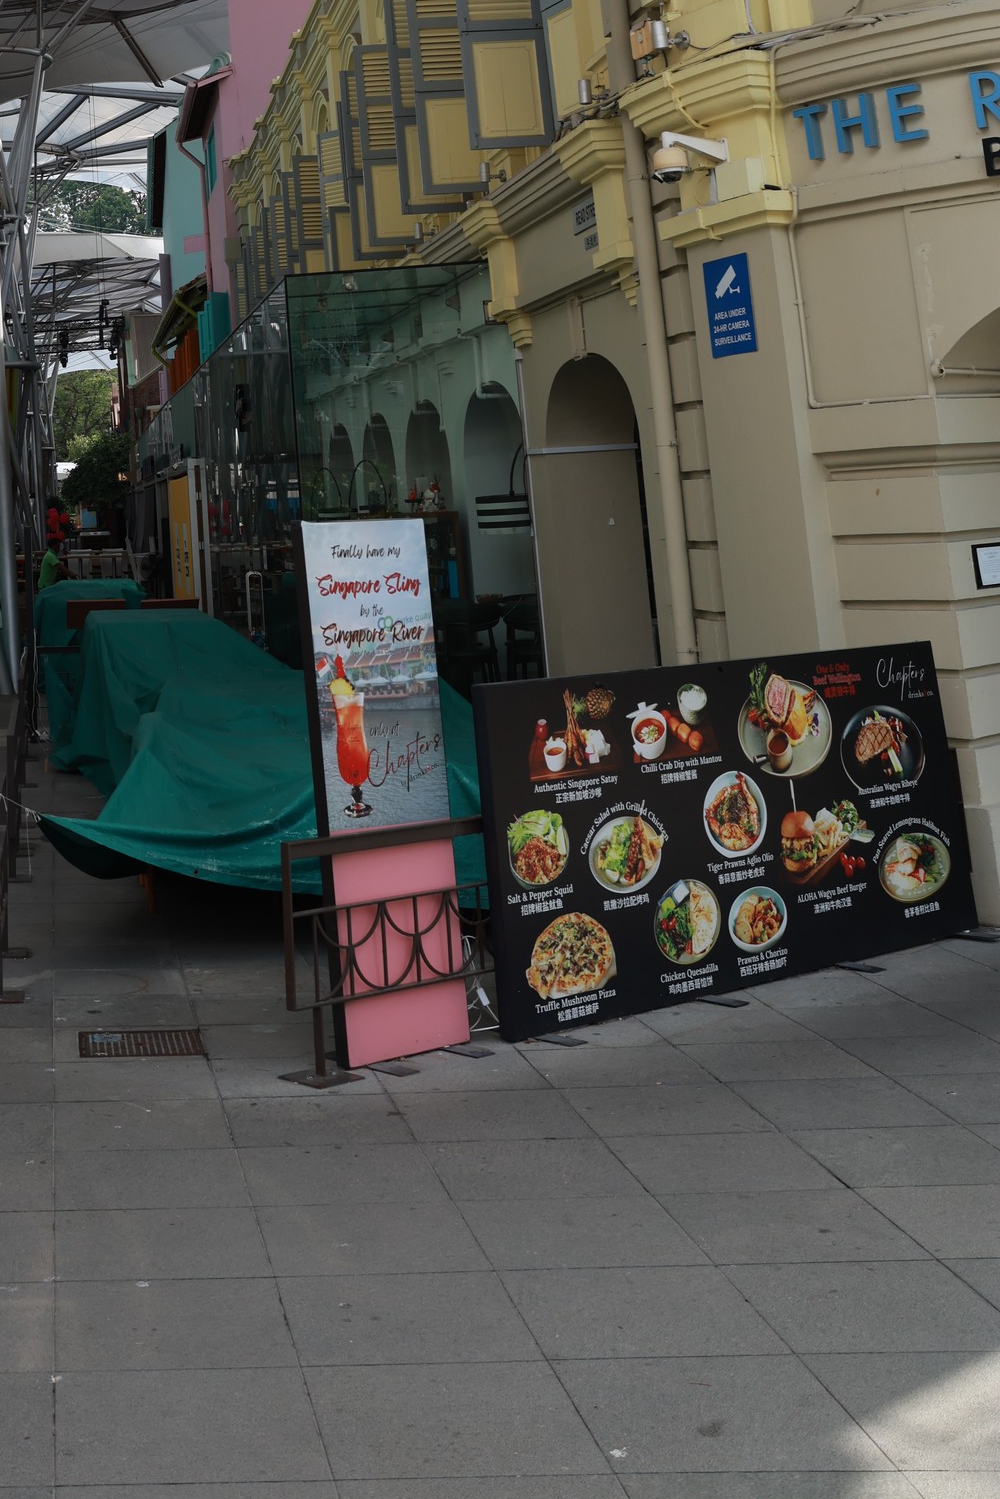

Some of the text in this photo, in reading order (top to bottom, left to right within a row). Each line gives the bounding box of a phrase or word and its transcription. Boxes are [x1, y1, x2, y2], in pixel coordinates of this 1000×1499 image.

[792, 83, 929, 161] THE
[714, 307, 746, 321] AREA UNDER
[713, 320, 750, 334] 24-HR CAMERA
[714, 332, 752, 347] SURVEILLANCE
[331, 544, 401, 559] Finally have my
[315, 572, 421, 600] Singapore Sling
[360, 604, 383, 618] by the
[320, 620, 425, 649] Singapore River
[812, 672, 862, 686] Beef Wellington
[876, 657, 925, 701] Chapters
[370, 721, 389, 737] only
[392, 721, 400, 736] at
[367, 731, 442, 792] Chapters
[640, 754, 722, 775] Chilli Crab Dip with Mantou
[534, 773, 619, 793] Authentic Singapore Satay
[858, 779, 918, 796] Australian Wagyu Ribeye
[580, 825, 597, 856] Caesar
[593, 806, 611, 827] Salad
[609, 801, 625, 815] with
[647, 811, 669, 842] Chicken
[872, 848, 881, 864] Pan
[878, 826, 893, 849] Seared
[892, 816, 922, 831] Lemongrass
[707, 853, 774, 875] Tiger Prawns Aglio Olio
[507, 884, 574, 905] Salt & Pepper Squid
[797, 881, 868, 903] ALOHA Wagyu Beef Burger
[737, 947, 788, 966] Prawns & Chorizo
[660, 962, 719, 984] Chicken Quesadilla
[535, 988, 616, 1014] Truffle Mushroom Pizza
